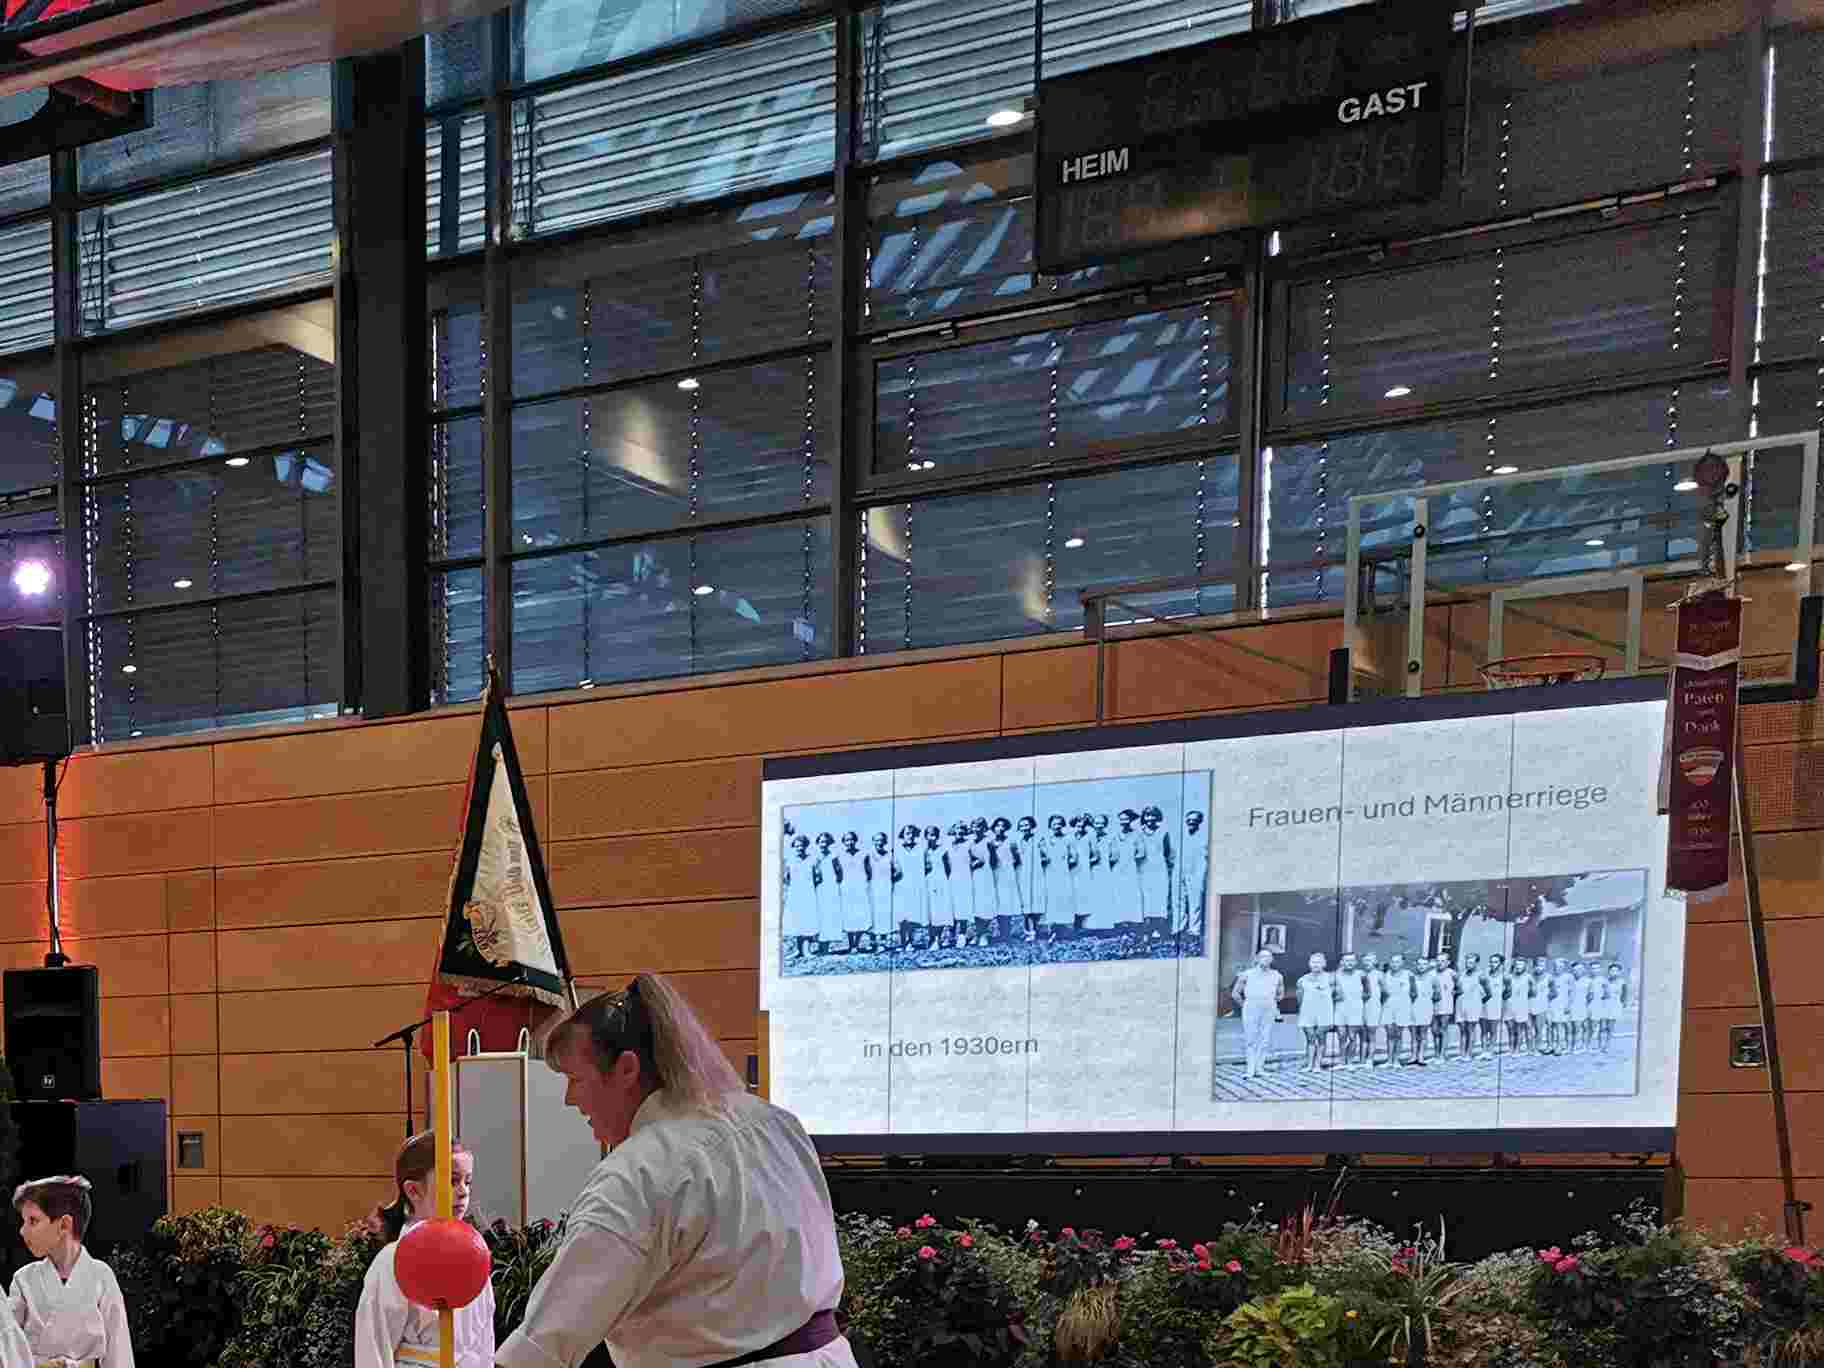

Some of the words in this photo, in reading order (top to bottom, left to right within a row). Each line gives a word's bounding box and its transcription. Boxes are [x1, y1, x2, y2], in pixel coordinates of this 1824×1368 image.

[1336, 81, 1428, 123] GAST
[1061, 147, 1130, 184] HEIM
[1248, 805, 1355, 828] Frauen-
[1363, 796, 1415, 820] und
[1424, 784, 1608, 815] Männerriege
[863, 1039, 882, 1058] in
[889, 1039, 933, 1057] den
[940, 1035, 1039, 1056] 1930ern
